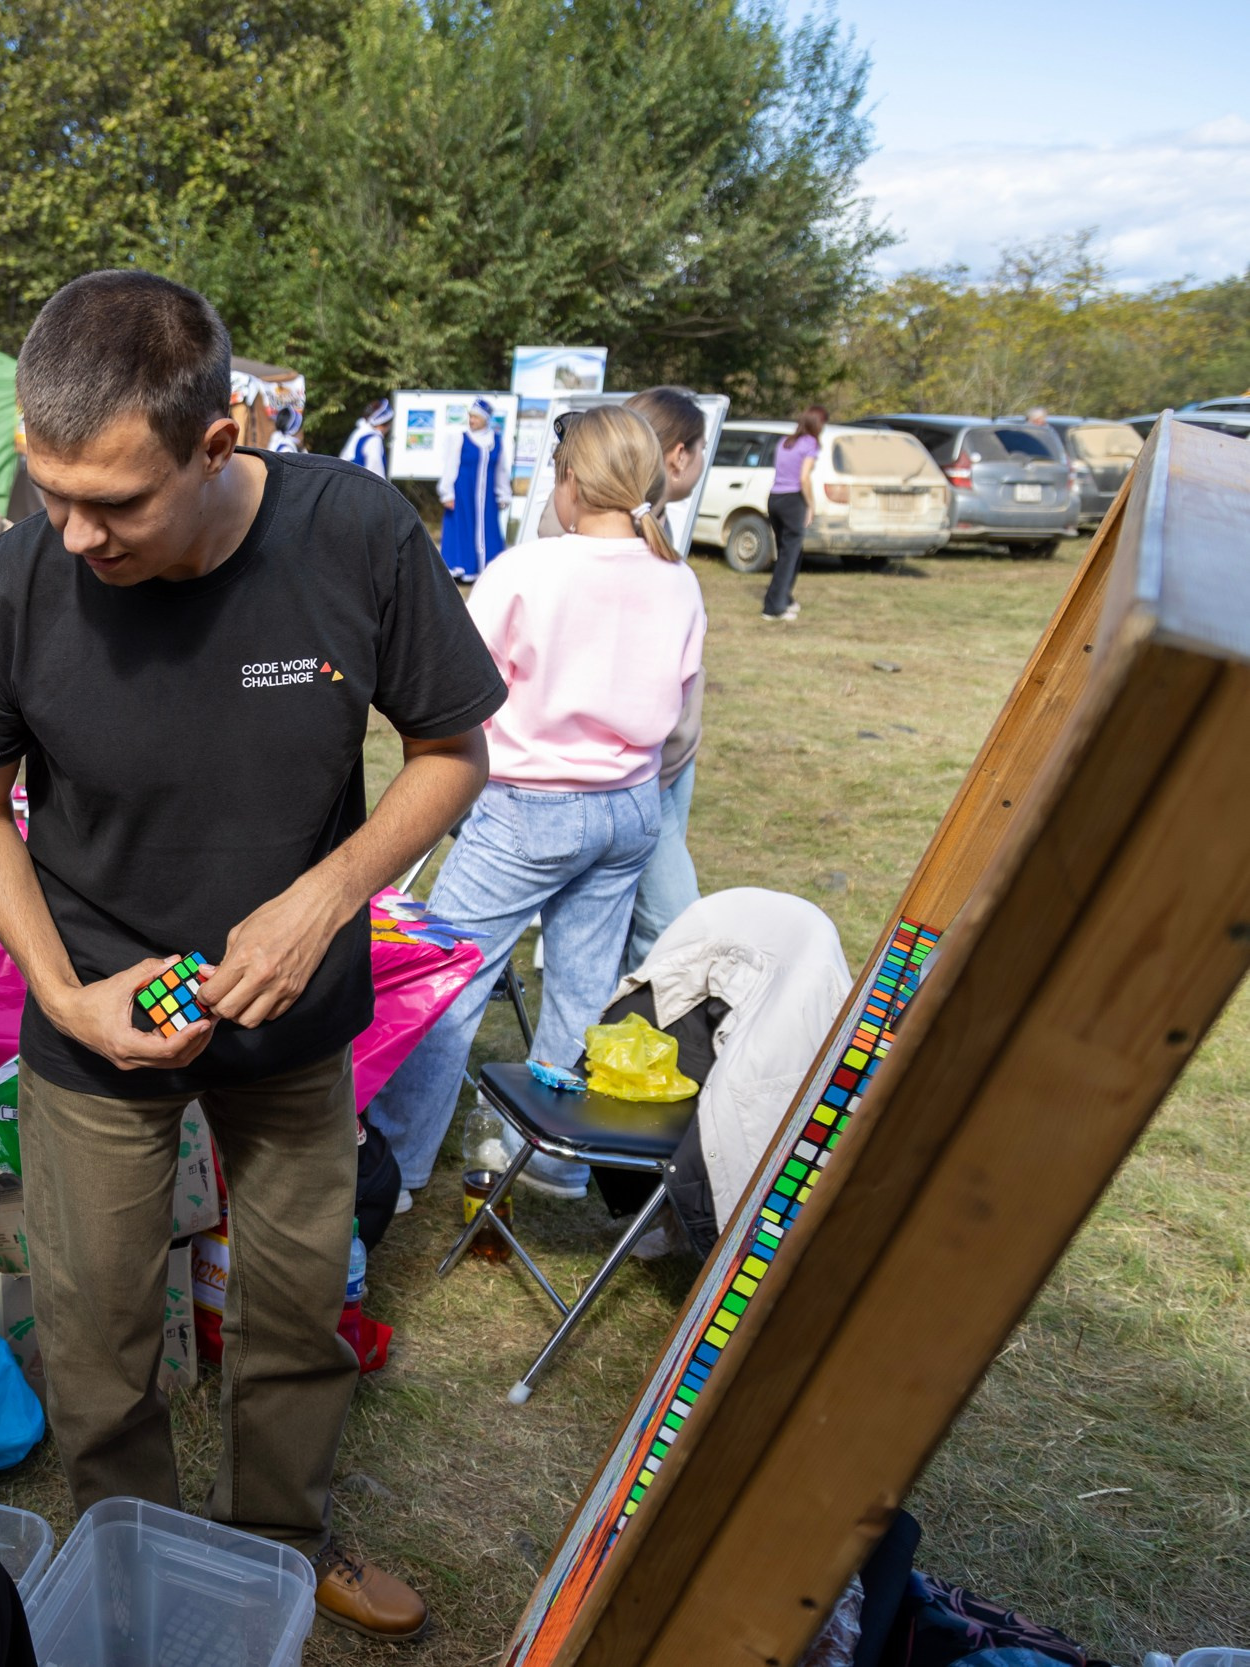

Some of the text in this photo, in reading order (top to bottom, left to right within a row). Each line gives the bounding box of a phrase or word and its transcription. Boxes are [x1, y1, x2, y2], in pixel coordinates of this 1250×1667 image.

[242, 658, 318, 676] CODE WORK
[242, 672, 314, 688] CHALLENGE
